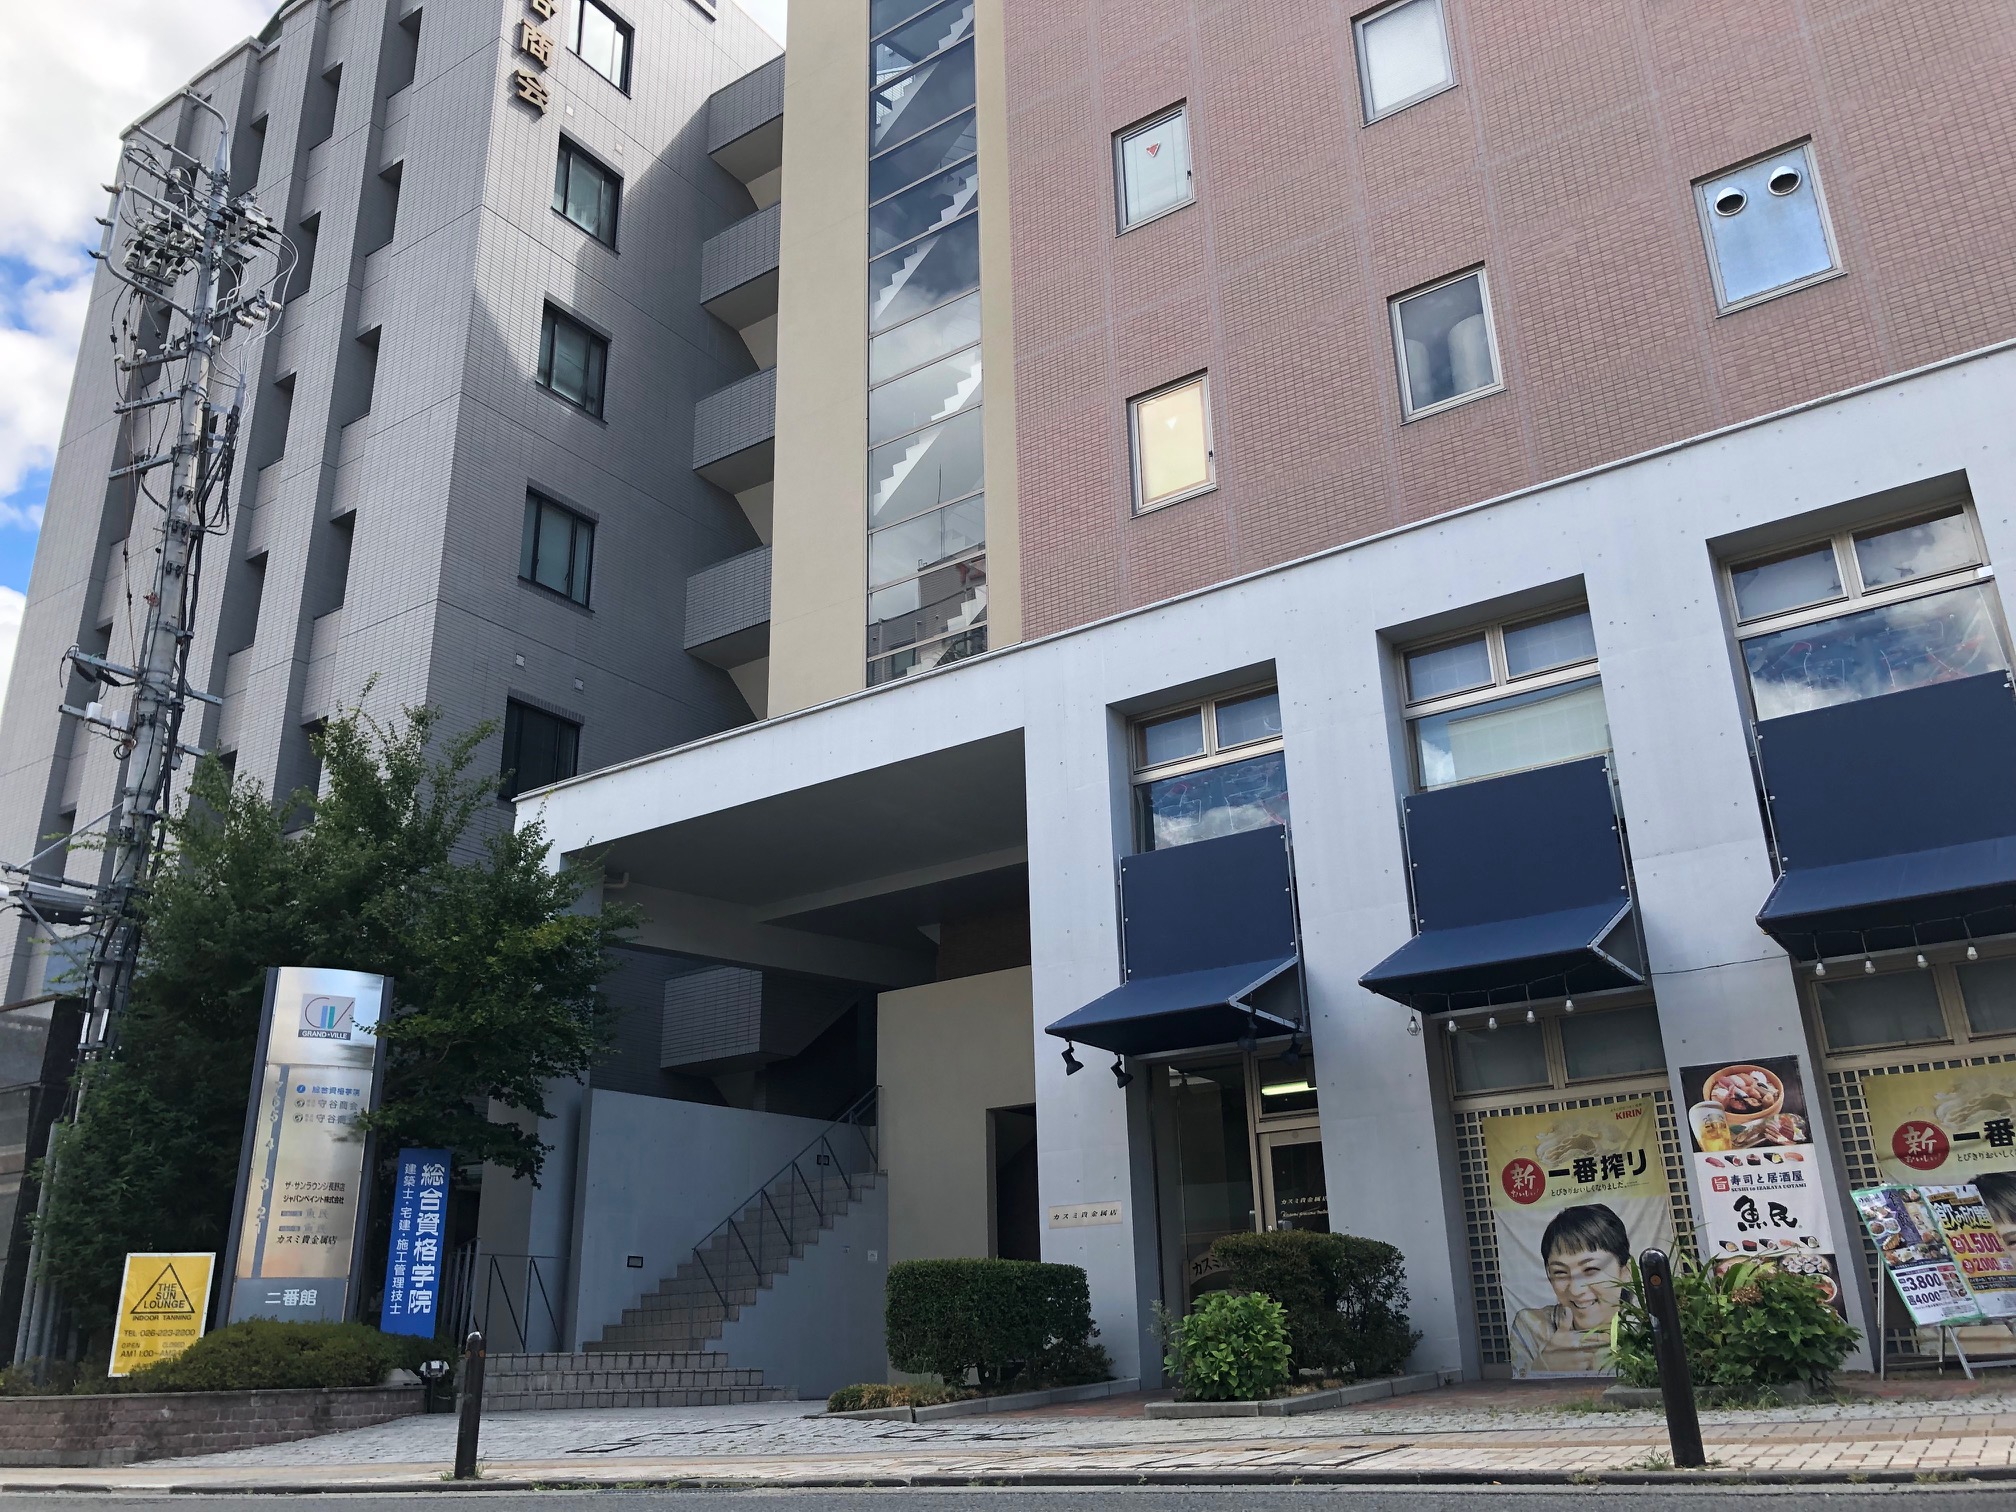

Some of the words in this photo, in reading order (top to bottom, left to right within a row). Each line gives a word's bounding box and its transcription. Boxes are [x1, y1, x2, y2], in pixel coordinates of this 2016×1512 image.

[1615, 1108, 1642, 1120] KIRIN
[265, 1138, 274, 1150] 4
[1902, 1126, 1937, 1155] 新
[1548, 1149, 1647, 1184] 一番搾り
[1510, 1163, 1536, 1190] 新
[1730, 1170, 1804, 1186] 寿司と居酒屋
[260, 1178, 270, 1191] 3
[1713, 1177, 1728, 1190] 旨
[256, 1206, 266, 1219] 2
[1733, 1195, 1798, 1232] 魚民
[277, 1235, 338, 1245] カスミ貴金属店
[407, 1162, 446, 1315] 総合資格学院
[158, 1283, 178, 1292] THE
[155, 1292, 177, 1301] SUN
[265, 1288, 318, 1306] 二番館
[143, 1300, 186, 1309] LOUNGE
